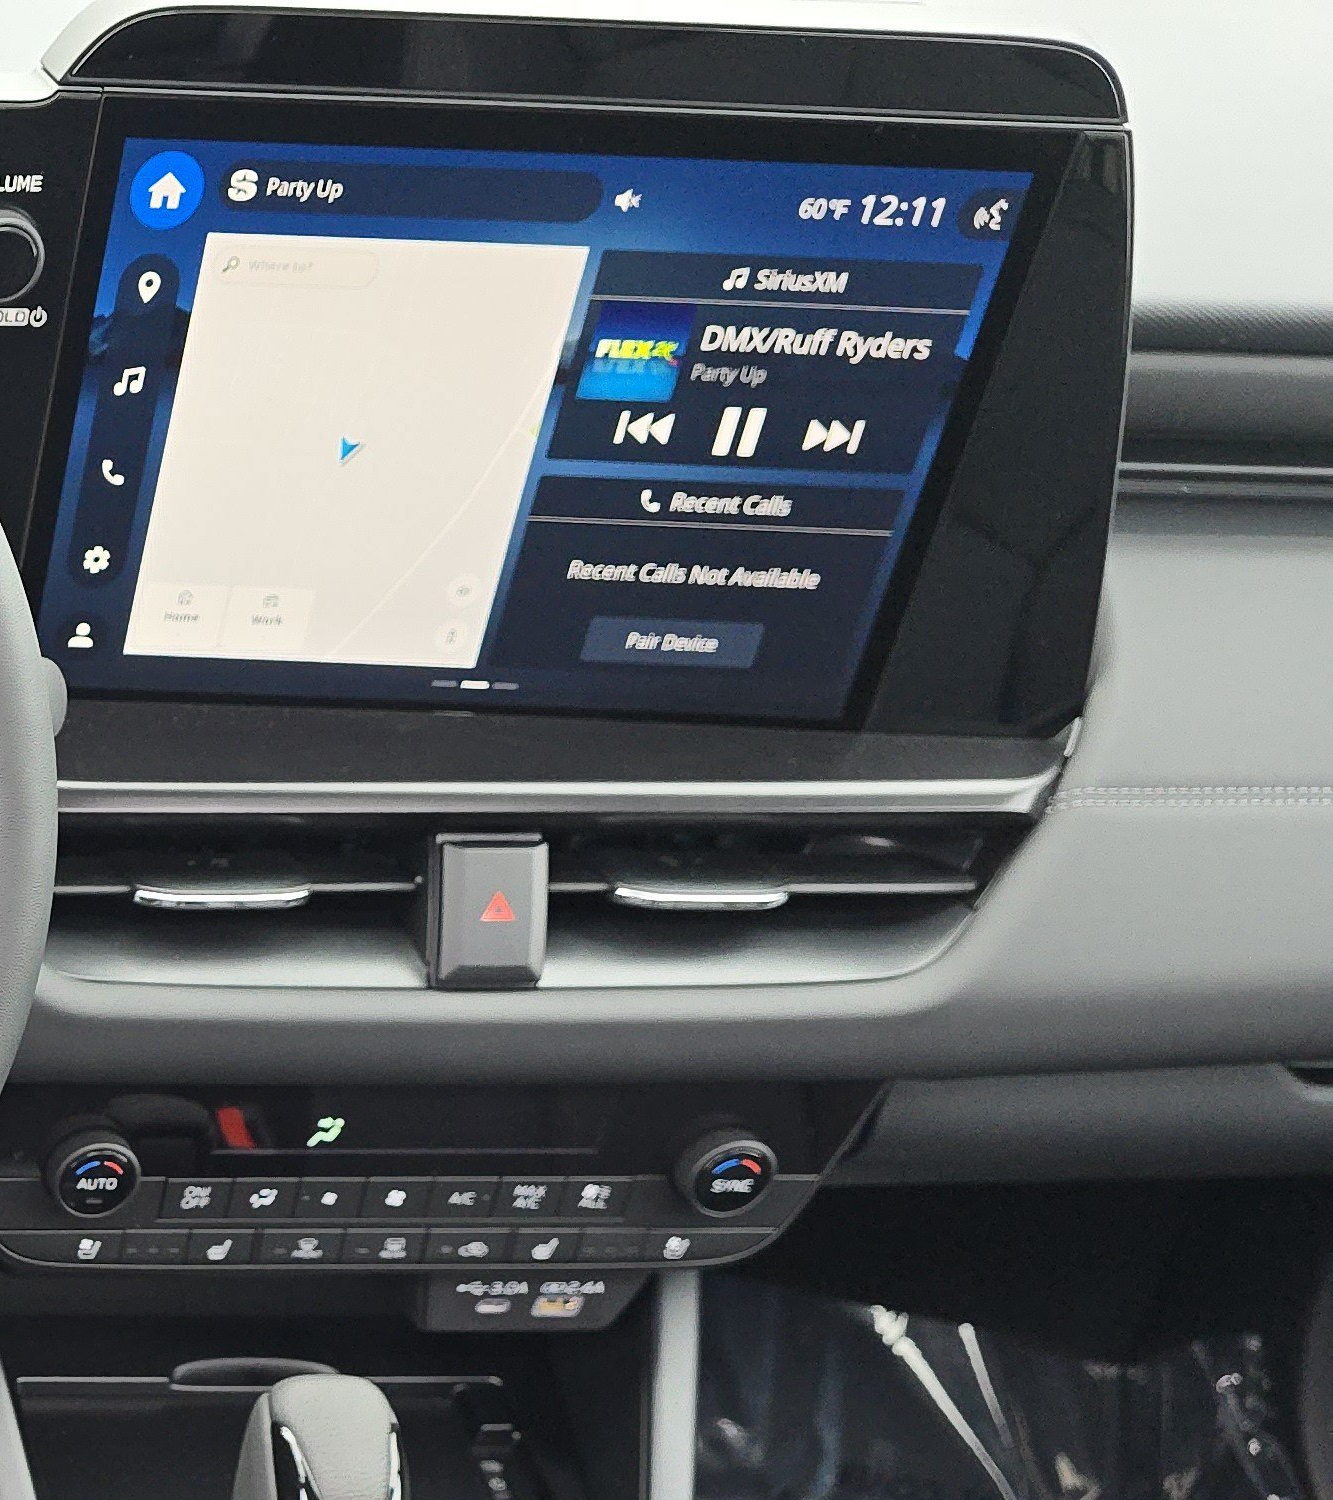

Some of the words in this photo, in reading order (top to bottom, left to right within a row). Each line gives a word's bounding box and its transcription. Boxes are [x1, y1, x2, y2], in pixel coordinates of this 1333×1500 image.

[266, 177, 315, 202] Party
[316, 179, 344, 203] Up
[860, 195, 947, 227] 12:11
[754, 269, 849, 294] SiriusXM
[699, 325, 838, 356] DMX/Ruff
[836, 331, 933, 365] Ryders
[690, 363, 738, 387] Party
[739, 364, 768, 388] Up
[669, 491, 742, 515] Recent
[742, 494, 793, 517] Calls
[567, 559, 638, 582] Recent
[639, 562, 687, 584] Calls
[688, 565, 730, 586] Not
[728, 566, 821, 590] Available
[625, 631, 661, 651] Pair
[661, 633, 719, 653] Device
[76, 1177, 118, 1191] AUTO
